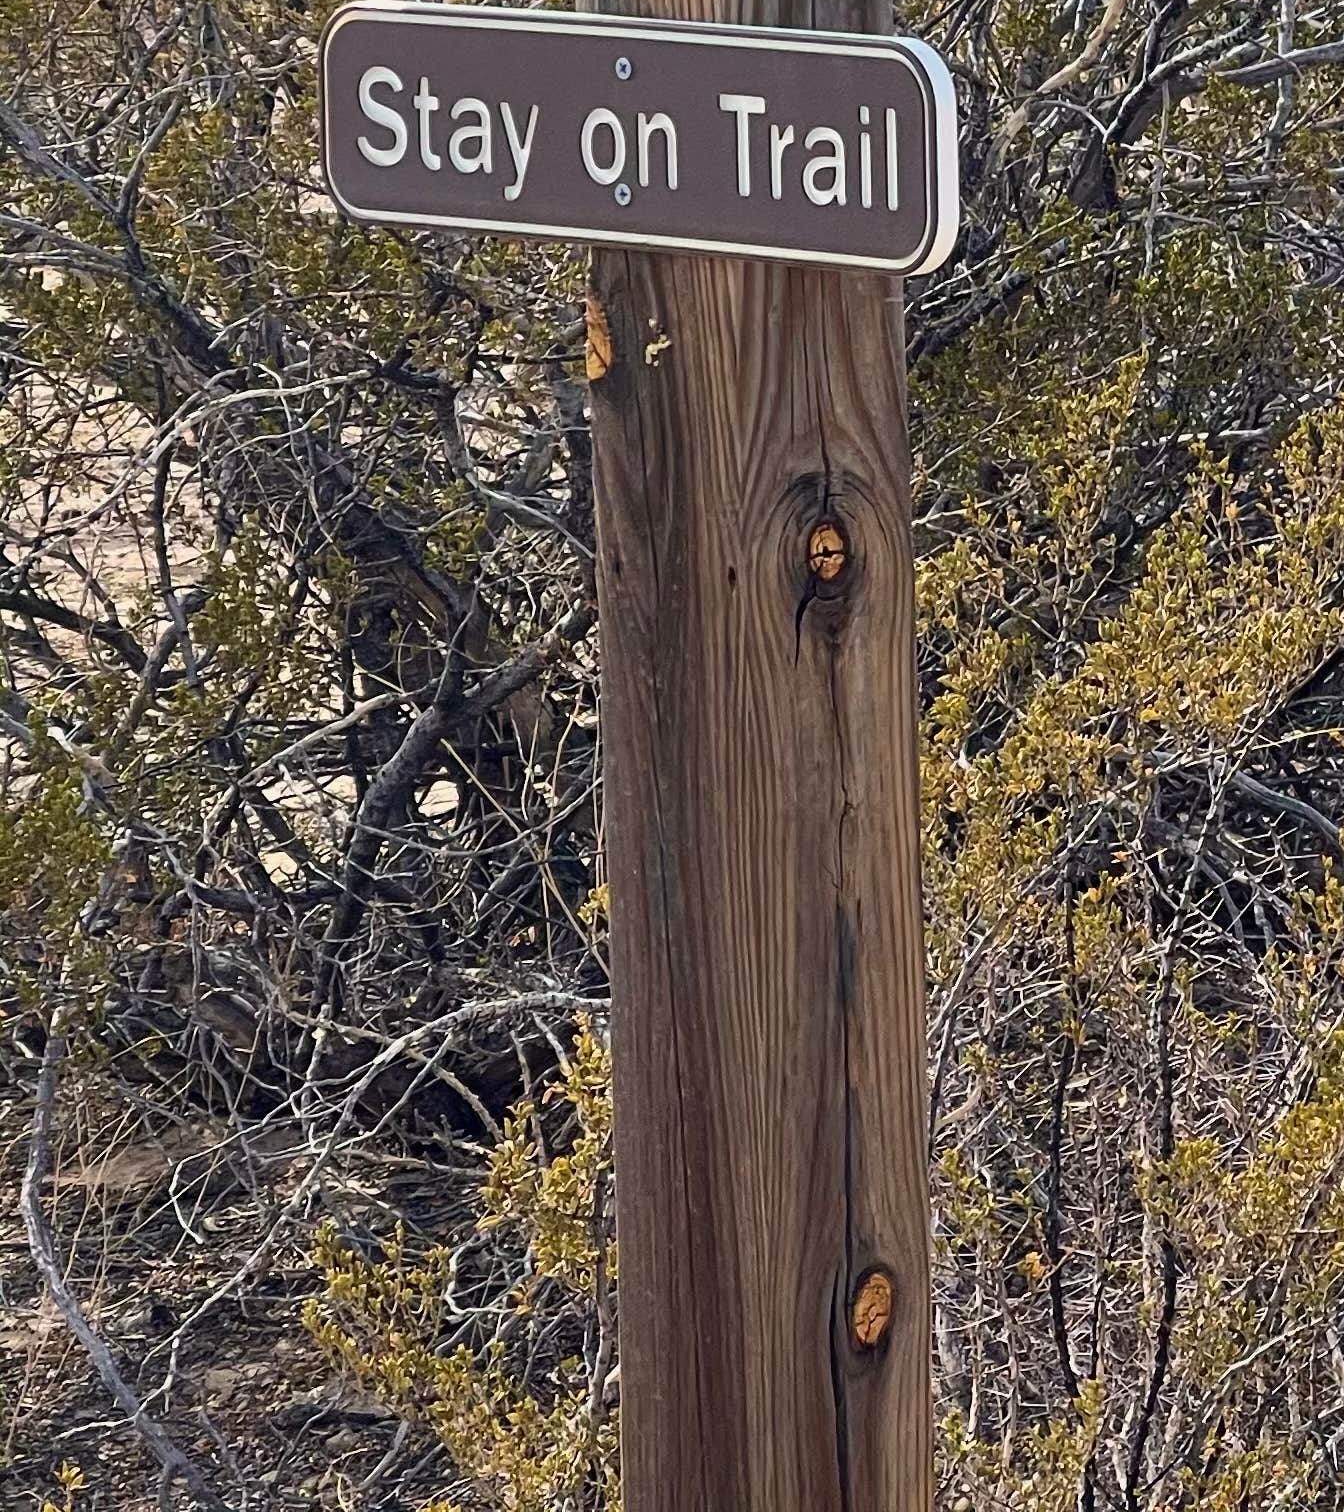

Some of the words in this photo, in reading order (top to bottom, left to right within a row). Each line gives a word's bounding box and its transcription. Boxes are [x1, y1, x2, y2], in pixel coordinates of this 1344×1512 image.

[356, 65, 540, 202] Stay
[580, 106, 679, 191] on
[718, 92, 900, 212] Trail
